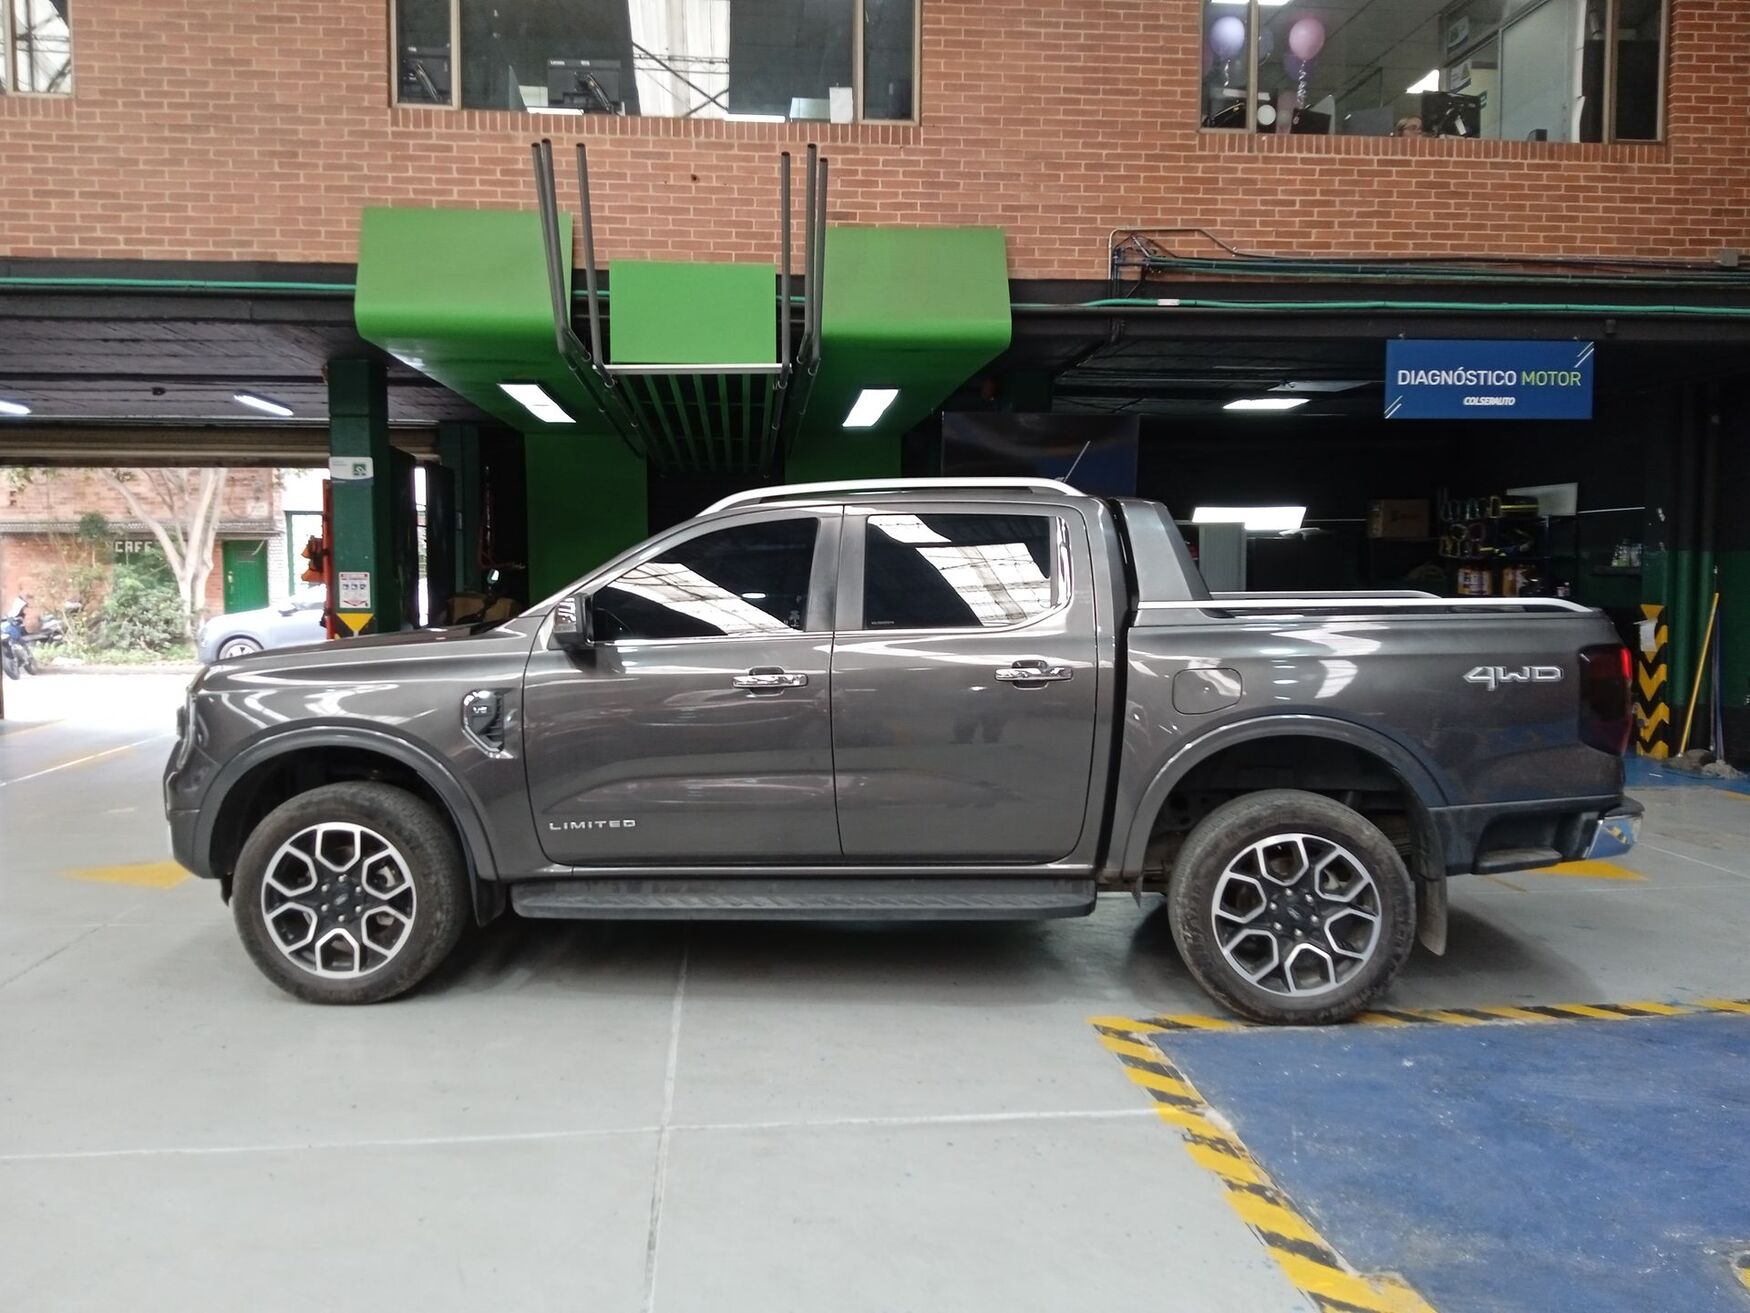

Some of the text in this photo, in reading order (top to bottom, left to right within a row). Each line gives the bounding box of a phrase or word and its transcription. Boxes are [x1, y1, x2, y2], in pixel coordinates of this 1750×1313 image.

[1397, 367, 1582, 386] DIAGNÓSTICO MOTOR
[1462, 666, 1564, 691] 4WD
[549, 819, 636, 831] LIMITED
